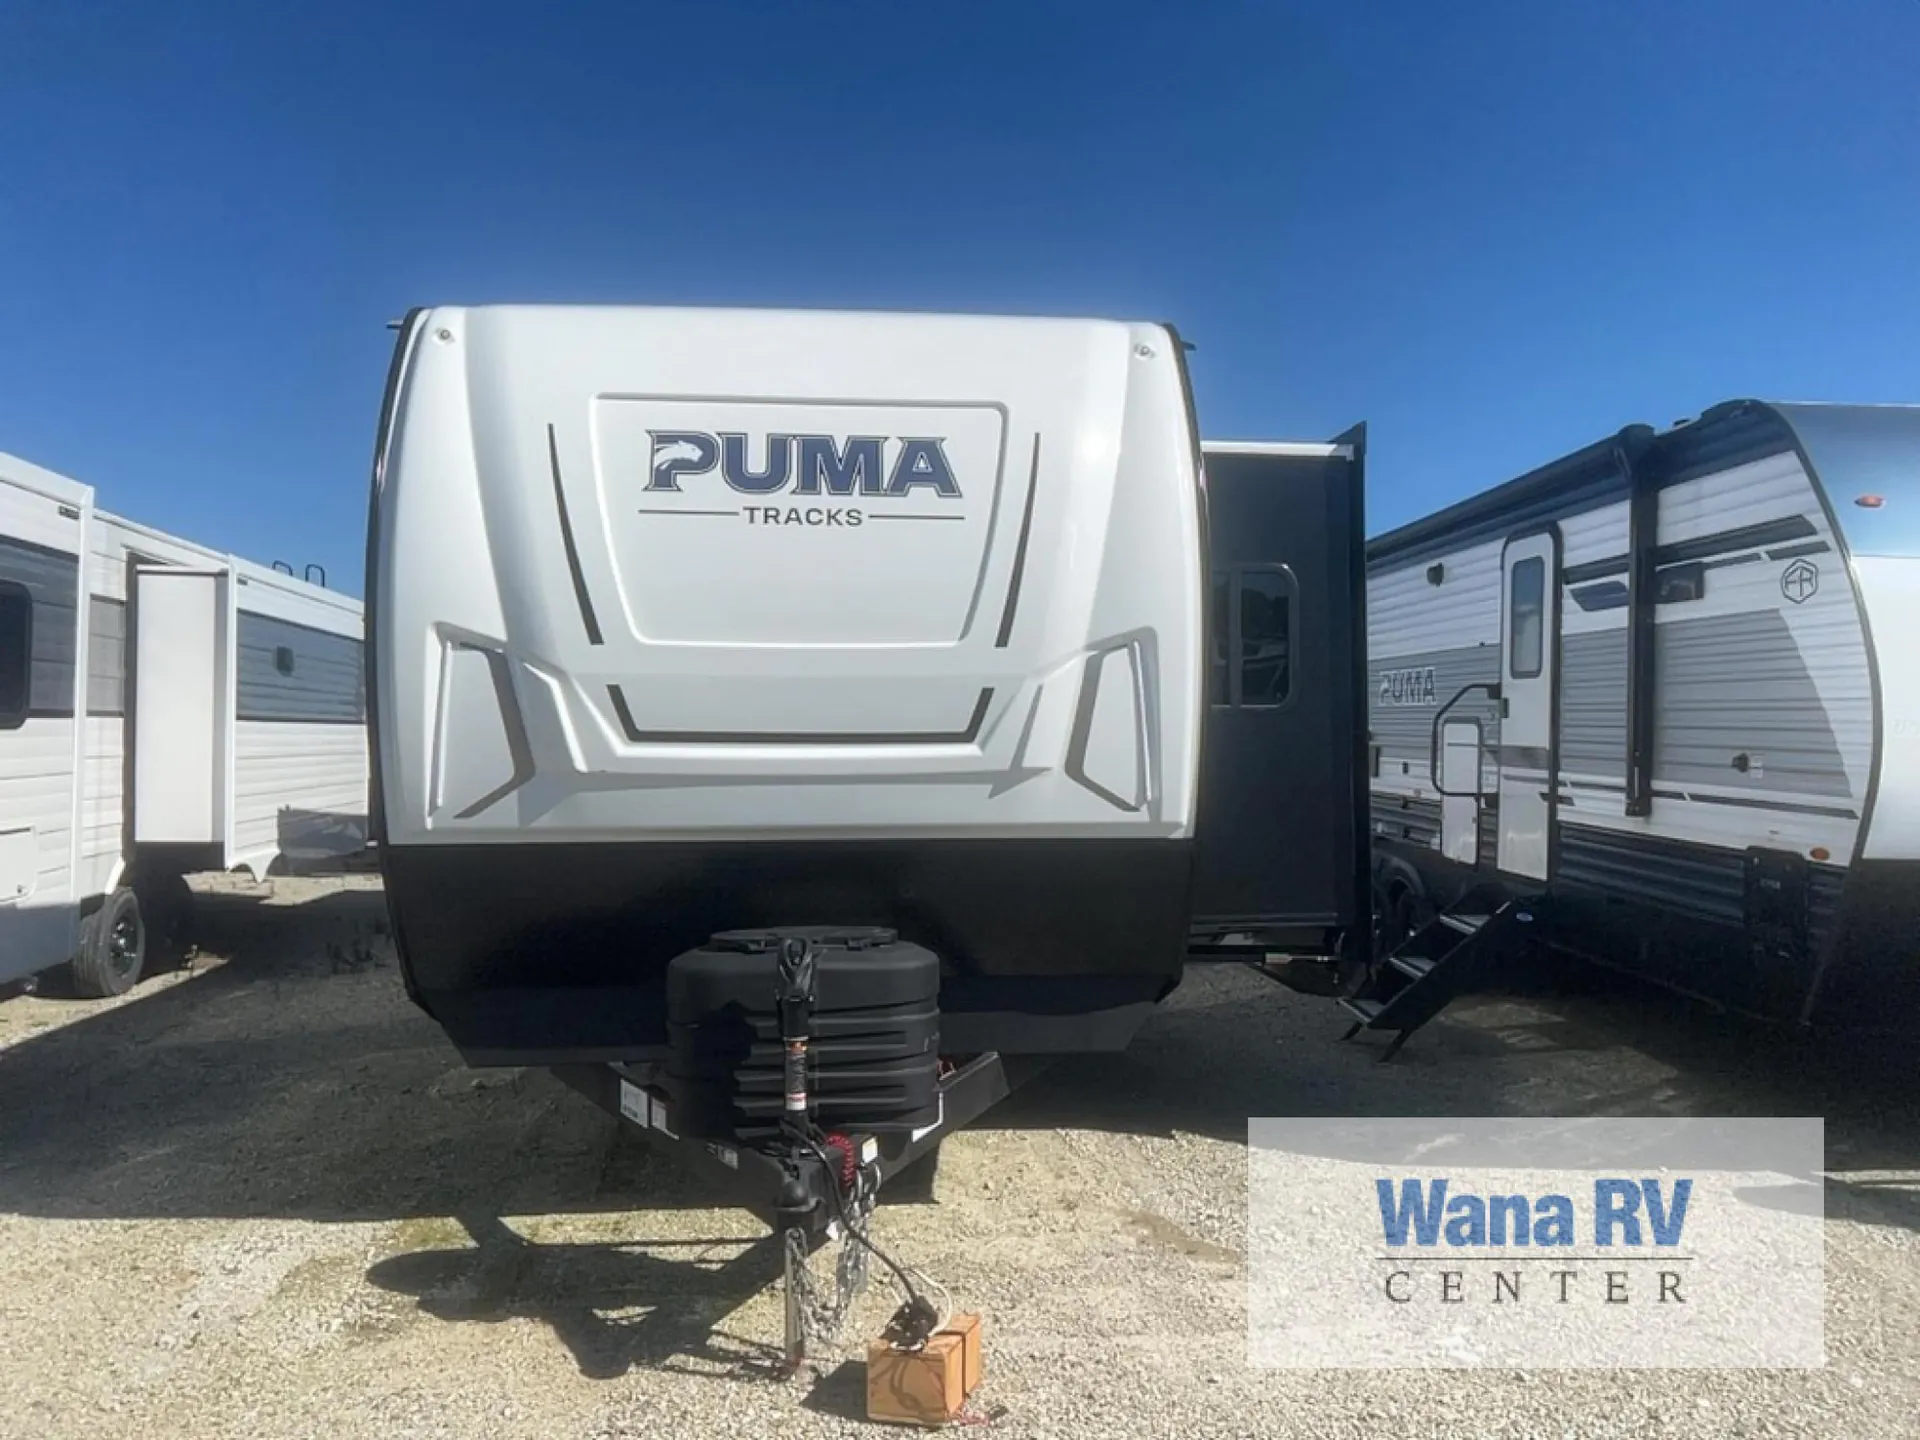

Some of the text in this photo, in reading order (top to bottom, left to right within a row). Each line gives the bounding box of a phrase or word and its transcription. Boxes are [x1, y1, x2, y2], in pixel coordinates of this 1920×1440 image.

[642, 429, 963, 498] PUMA
[743, 506, 863, 526] TRACKS
[1378, 666, 1436, 706] PUMA
